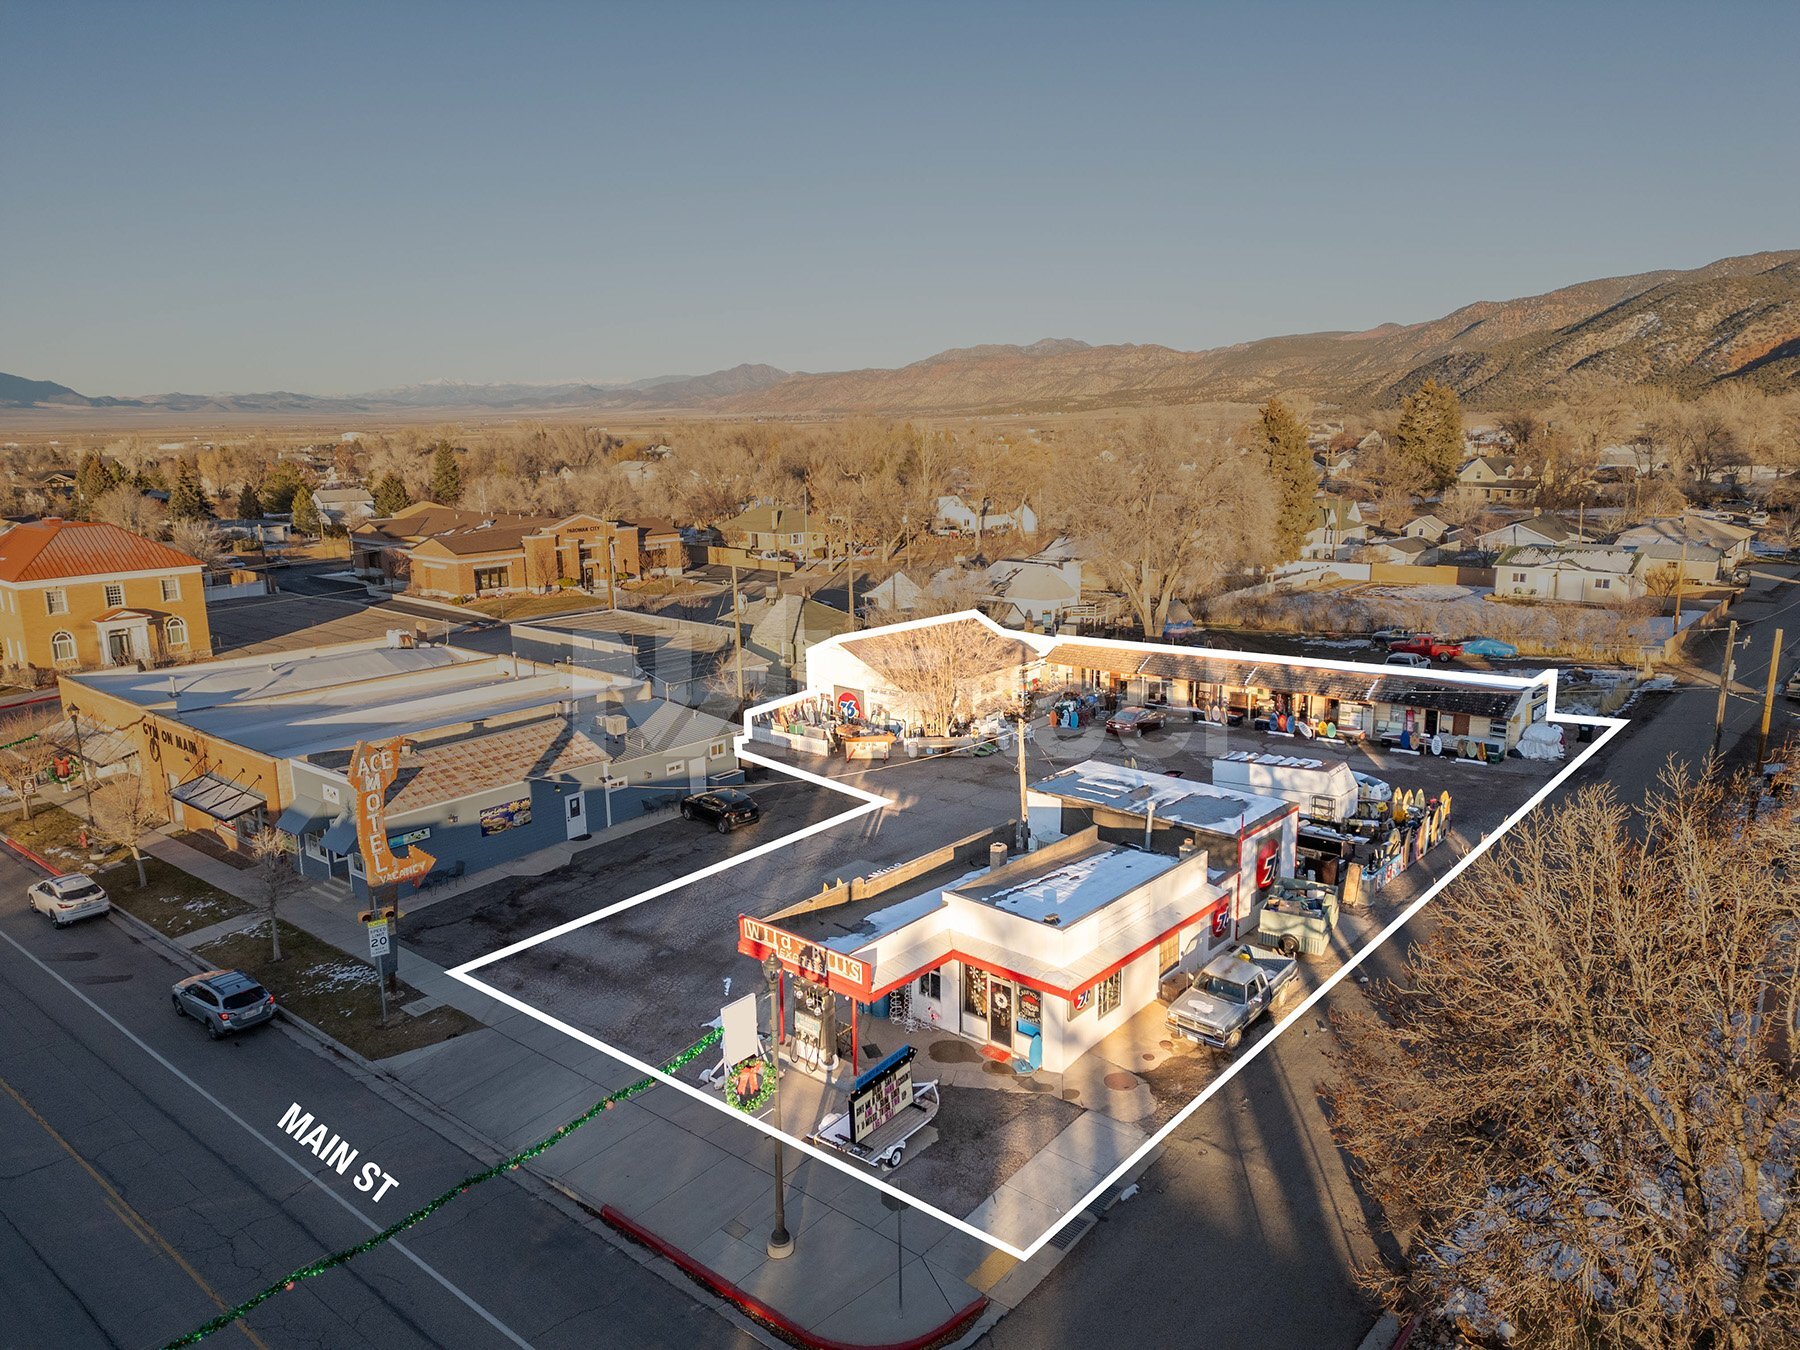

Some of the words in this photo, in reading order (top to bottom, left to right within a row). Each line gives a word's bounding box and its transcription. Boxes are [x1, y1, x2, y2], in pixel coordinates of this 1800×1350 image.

[839, 700, 857, 718] 76
[142, 722, 159, 740] GYM
[161, 730, 173, 745] ON
[175, 735, 198, 755] MAIN
[357, 750, 394, 777] ACE
[364, 772, 388, 873] MOTEL
[379, 860, 427, 884] VACANCY
[371, 936, 387, 948] 20
